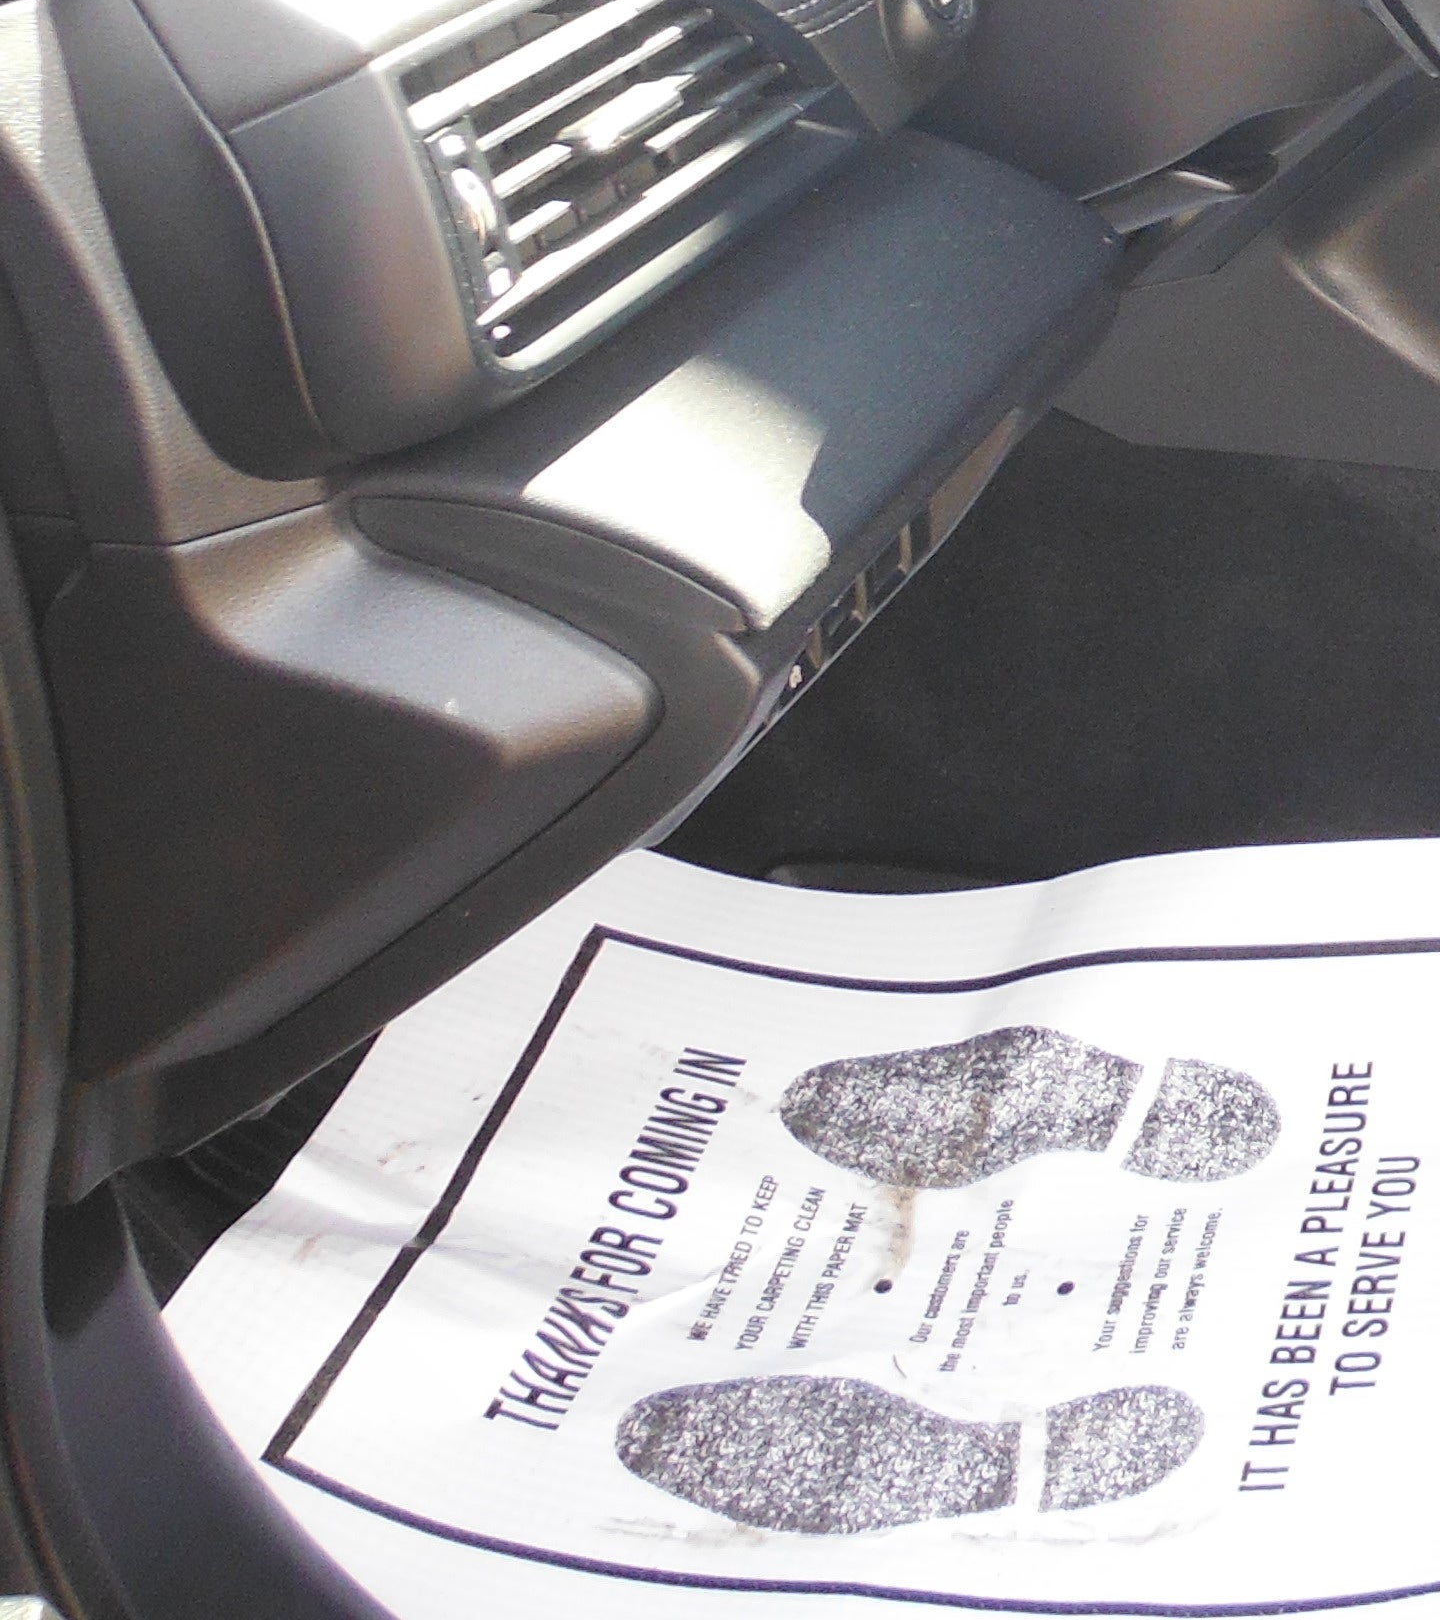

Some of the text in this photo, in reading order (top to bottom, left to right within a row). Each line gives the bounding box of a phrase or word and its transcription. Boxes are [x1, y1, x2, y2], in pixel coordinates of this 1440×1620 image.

[483, 1046, 748, 1431] THANKS FOR COMING IN
[701, 1285, 733, 1320] HAVE
[719, 1241, 753, 1285] TRIED
[739, 1214, 764, 1236] TO
[752, 1174, 779, 1212] KEEP
[736, 1186, 827, 1351] YOUR CARPETING CLEAN
[786, 1202, 869, 1350] WITH THIS PAPER MAT
[909, 1322, 933, 1343] Our
[951, 1230, 970, 1250] are
[938, 1198, 1015, 1372] the most important people
[1092, 1319, 1117, 1352] Your
[1129, 1214, 1150, 1233] for
[1128, 1207, 1188, 1354] improving our service
[1172, 1207, 1224, 1351] are always welcome.
[1238, 1061, 1374, 1492] IT HAS BEEN A PLEASURE
[1329, 1155, 1422, 1396] TO SERVE YOU
